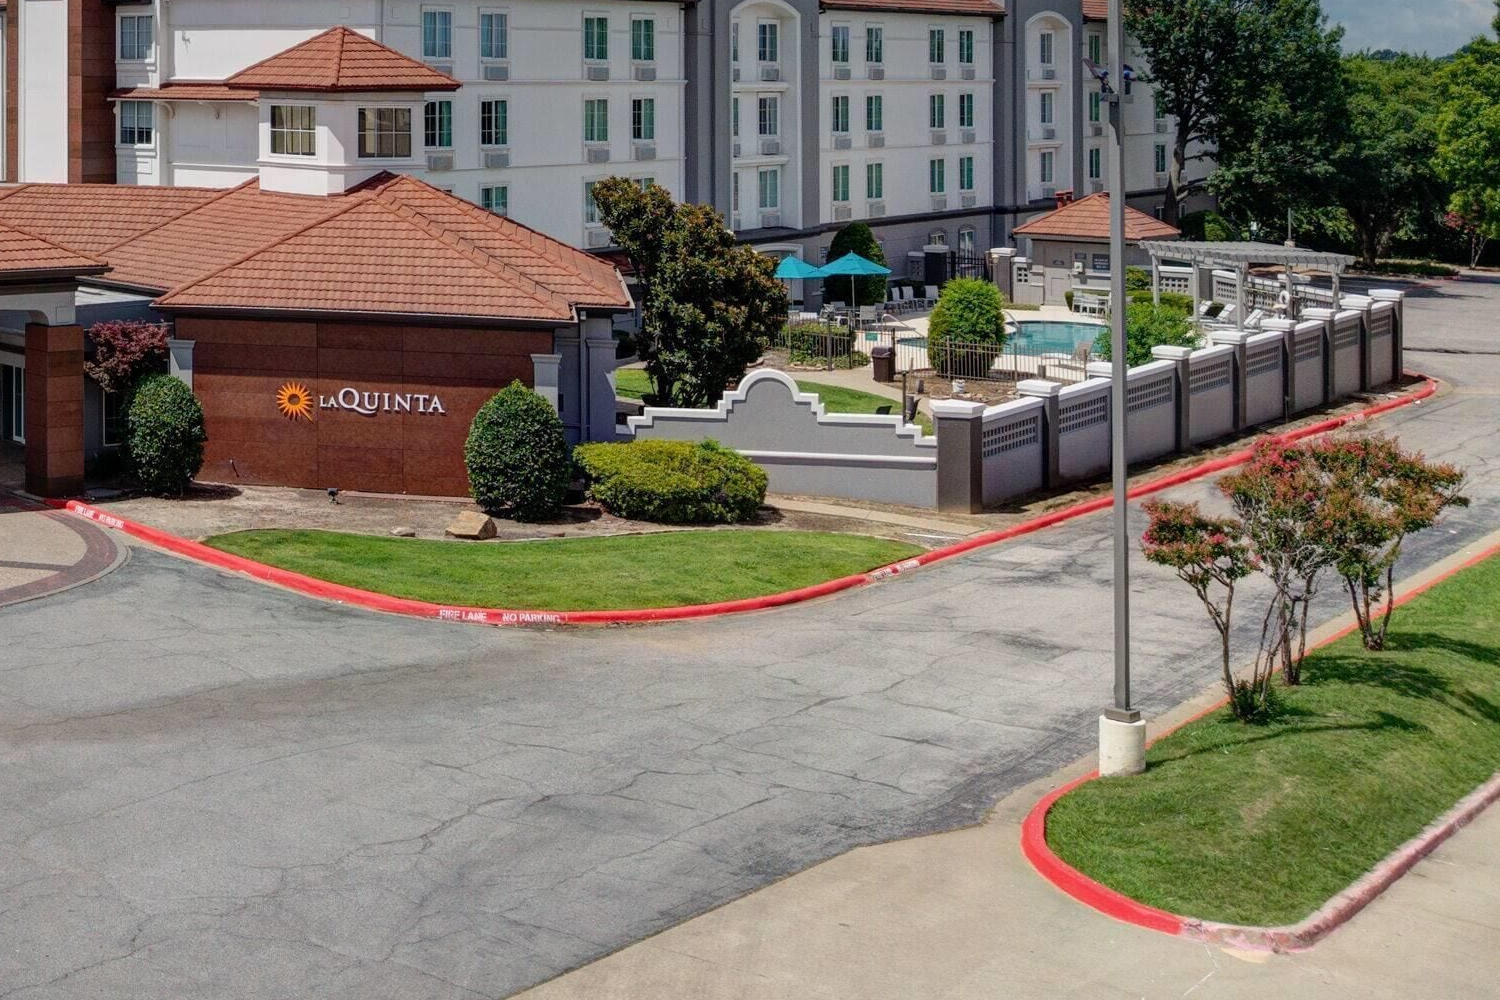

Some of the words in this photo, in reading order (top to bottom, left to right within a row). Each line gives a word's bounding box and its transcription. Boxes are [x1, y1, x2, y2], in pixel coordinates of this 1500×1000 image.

[319, 395, 338, 408] LA
[338, 387, 446, 414] QUINTA
[440, 609, 460, 619] FIRE
[462, 611, 487, 622] LANE
[503, 612, 517, 622] NO
[519, 612, 561, 623] PARKING
